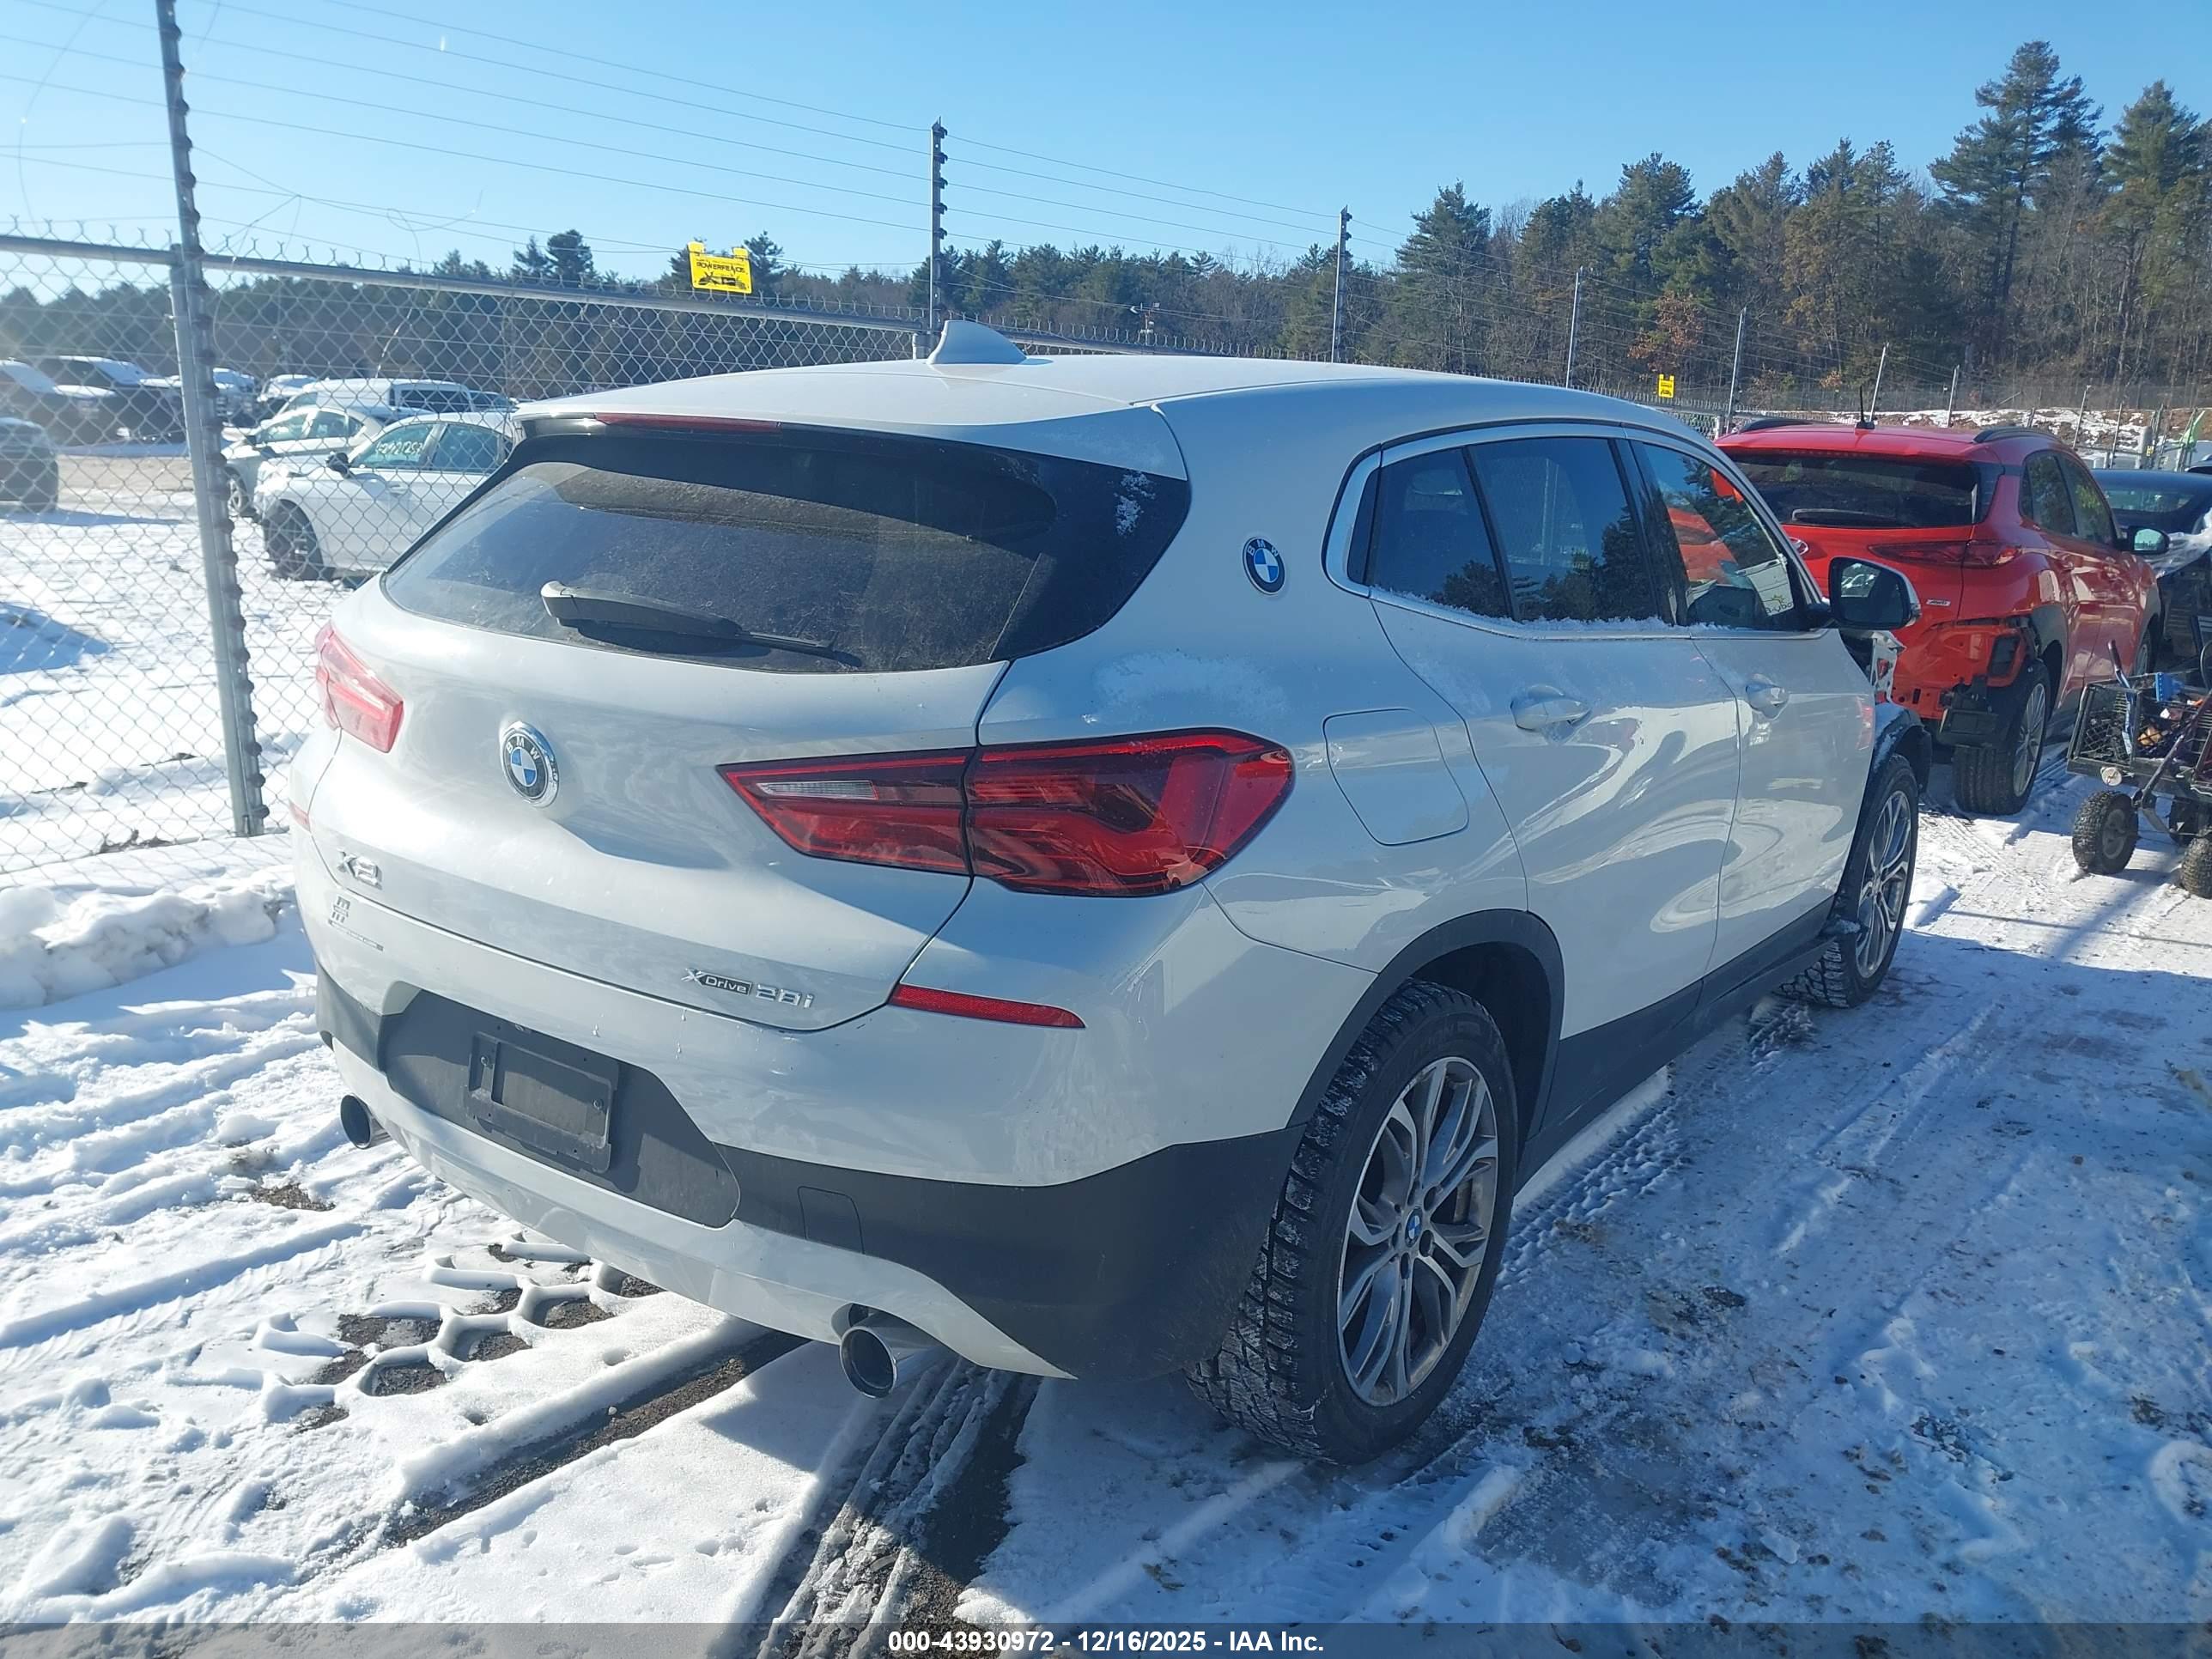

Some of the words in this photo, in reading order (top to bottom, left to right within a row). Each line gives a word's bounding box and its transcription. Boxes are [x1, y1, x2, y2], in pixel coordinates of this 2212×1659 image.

[505, 735, 541, 761] BMW
[336, 848, 383, 890] X2
[755, 984, 814, 1009] 28i
